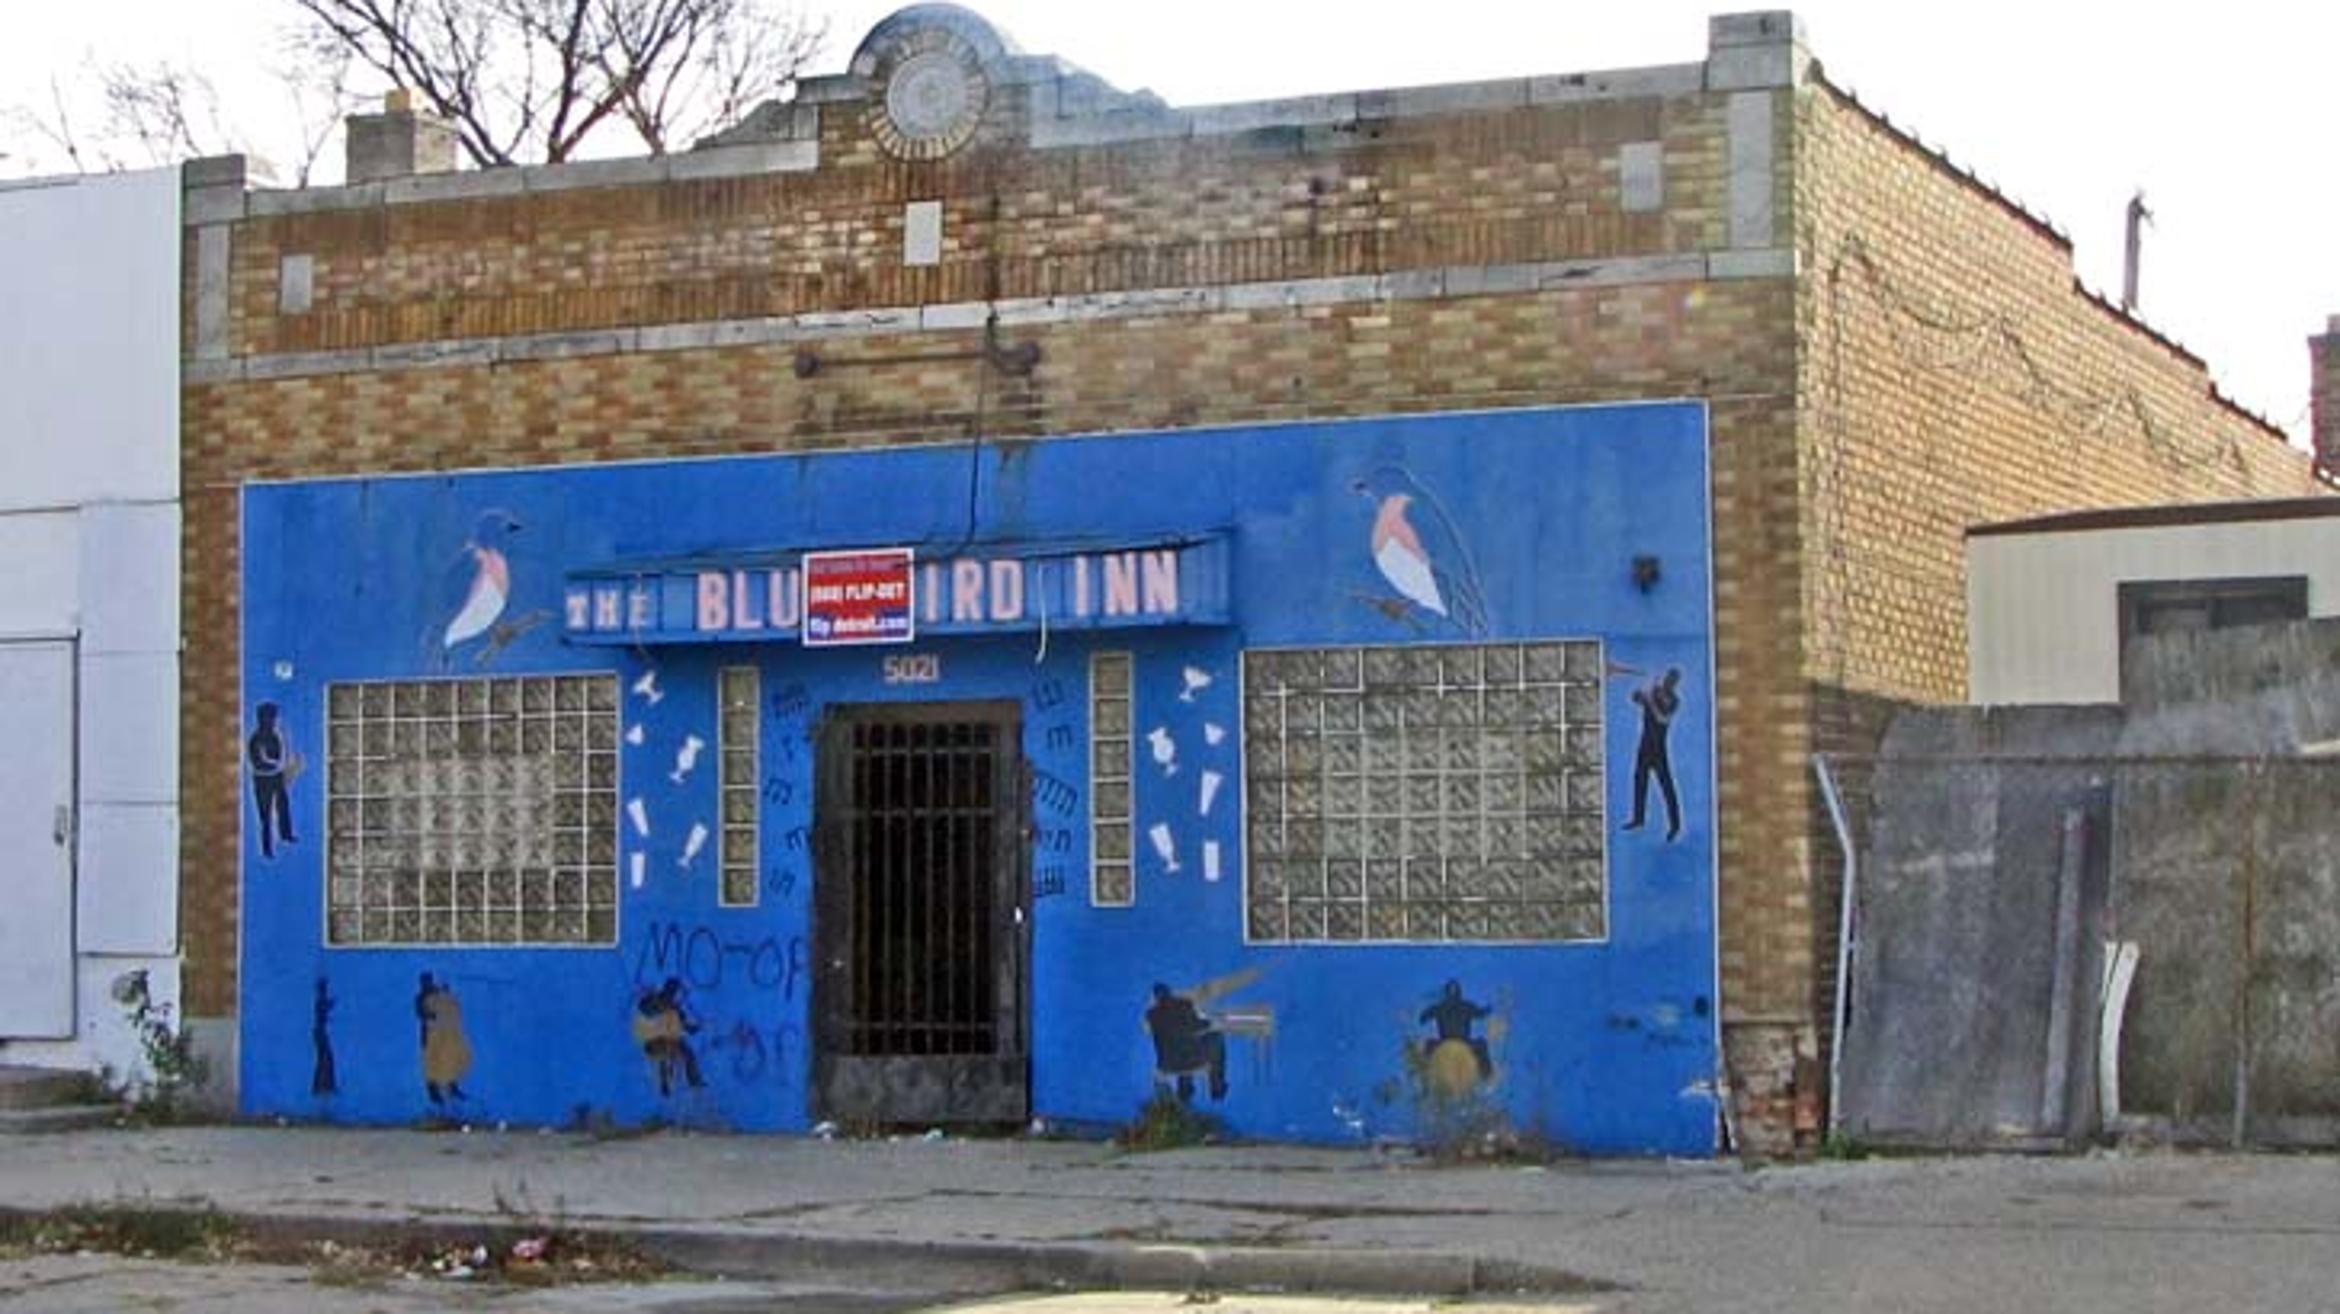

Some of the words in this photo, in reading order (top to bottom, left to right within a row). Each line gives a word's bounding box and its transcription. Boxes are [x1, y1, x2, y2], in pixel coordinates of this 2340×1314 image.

[566, 588, 648, 630] THE
[1075, 550, 1178, 617] INN
[883, 654, 940, 683] 5021
